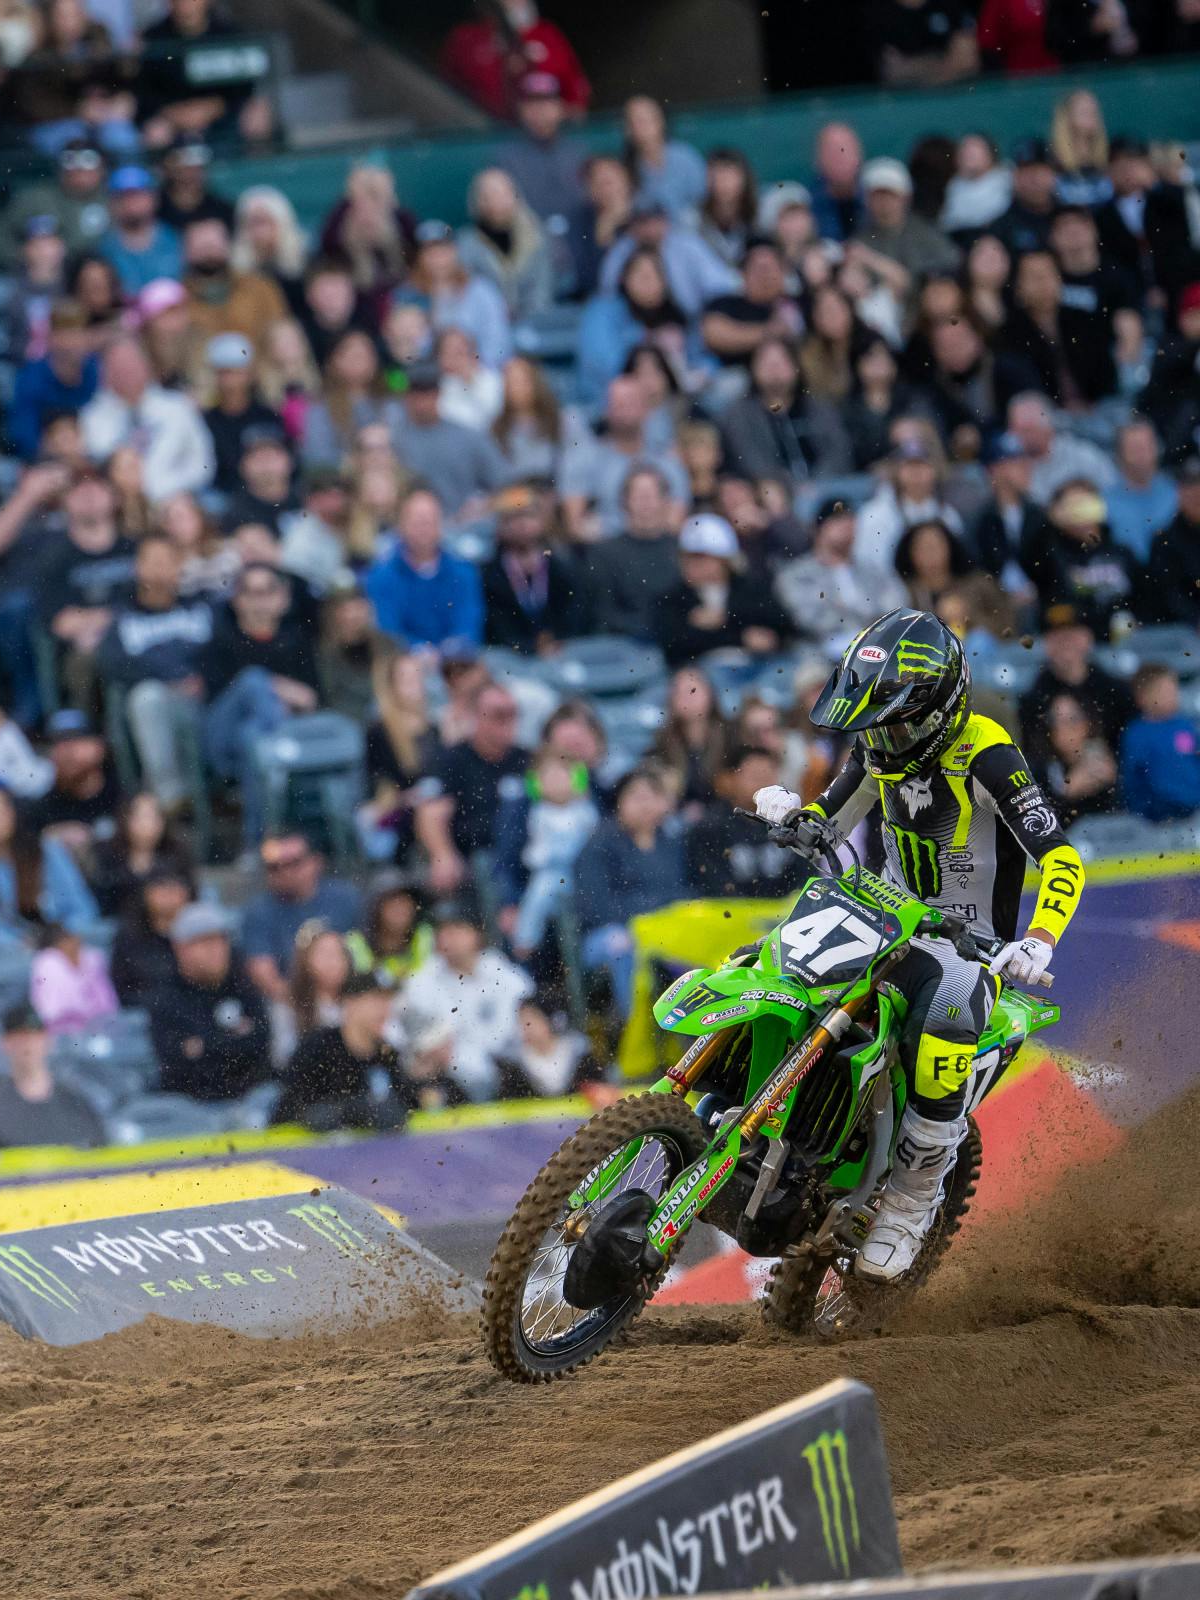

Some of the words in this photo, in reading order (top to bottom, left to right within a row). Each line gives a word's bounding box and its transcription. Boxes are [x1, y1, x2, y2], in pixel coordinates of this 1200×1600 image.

[861, 649, 883, 660] BELL
[1010, 785, 1038, 804] GARMIN
[828, 890, 879, 922] SUPERCROSS
[1042, 859, 1079, 918] FOX
[780, 905, 889, 976] 47
[784, 961, 817, 984] Kawasaki
[740, 990, 765, 1001] PRO
[765, 992, 807, 1011] CIRCUIT
[752, 1084, 777, 1114] PRO
[773, 1036, 814, 1089] CIRCUIT
[648, 1158, 709, 1238] DUNLOP
[698, 1155, 735, 1201] BRAKING
[52, 1219, 306, 1275] MONSTER
[140, 1265, 298, 1297] ENERGY
[571, 1476, 798, 1600] MONSTER
